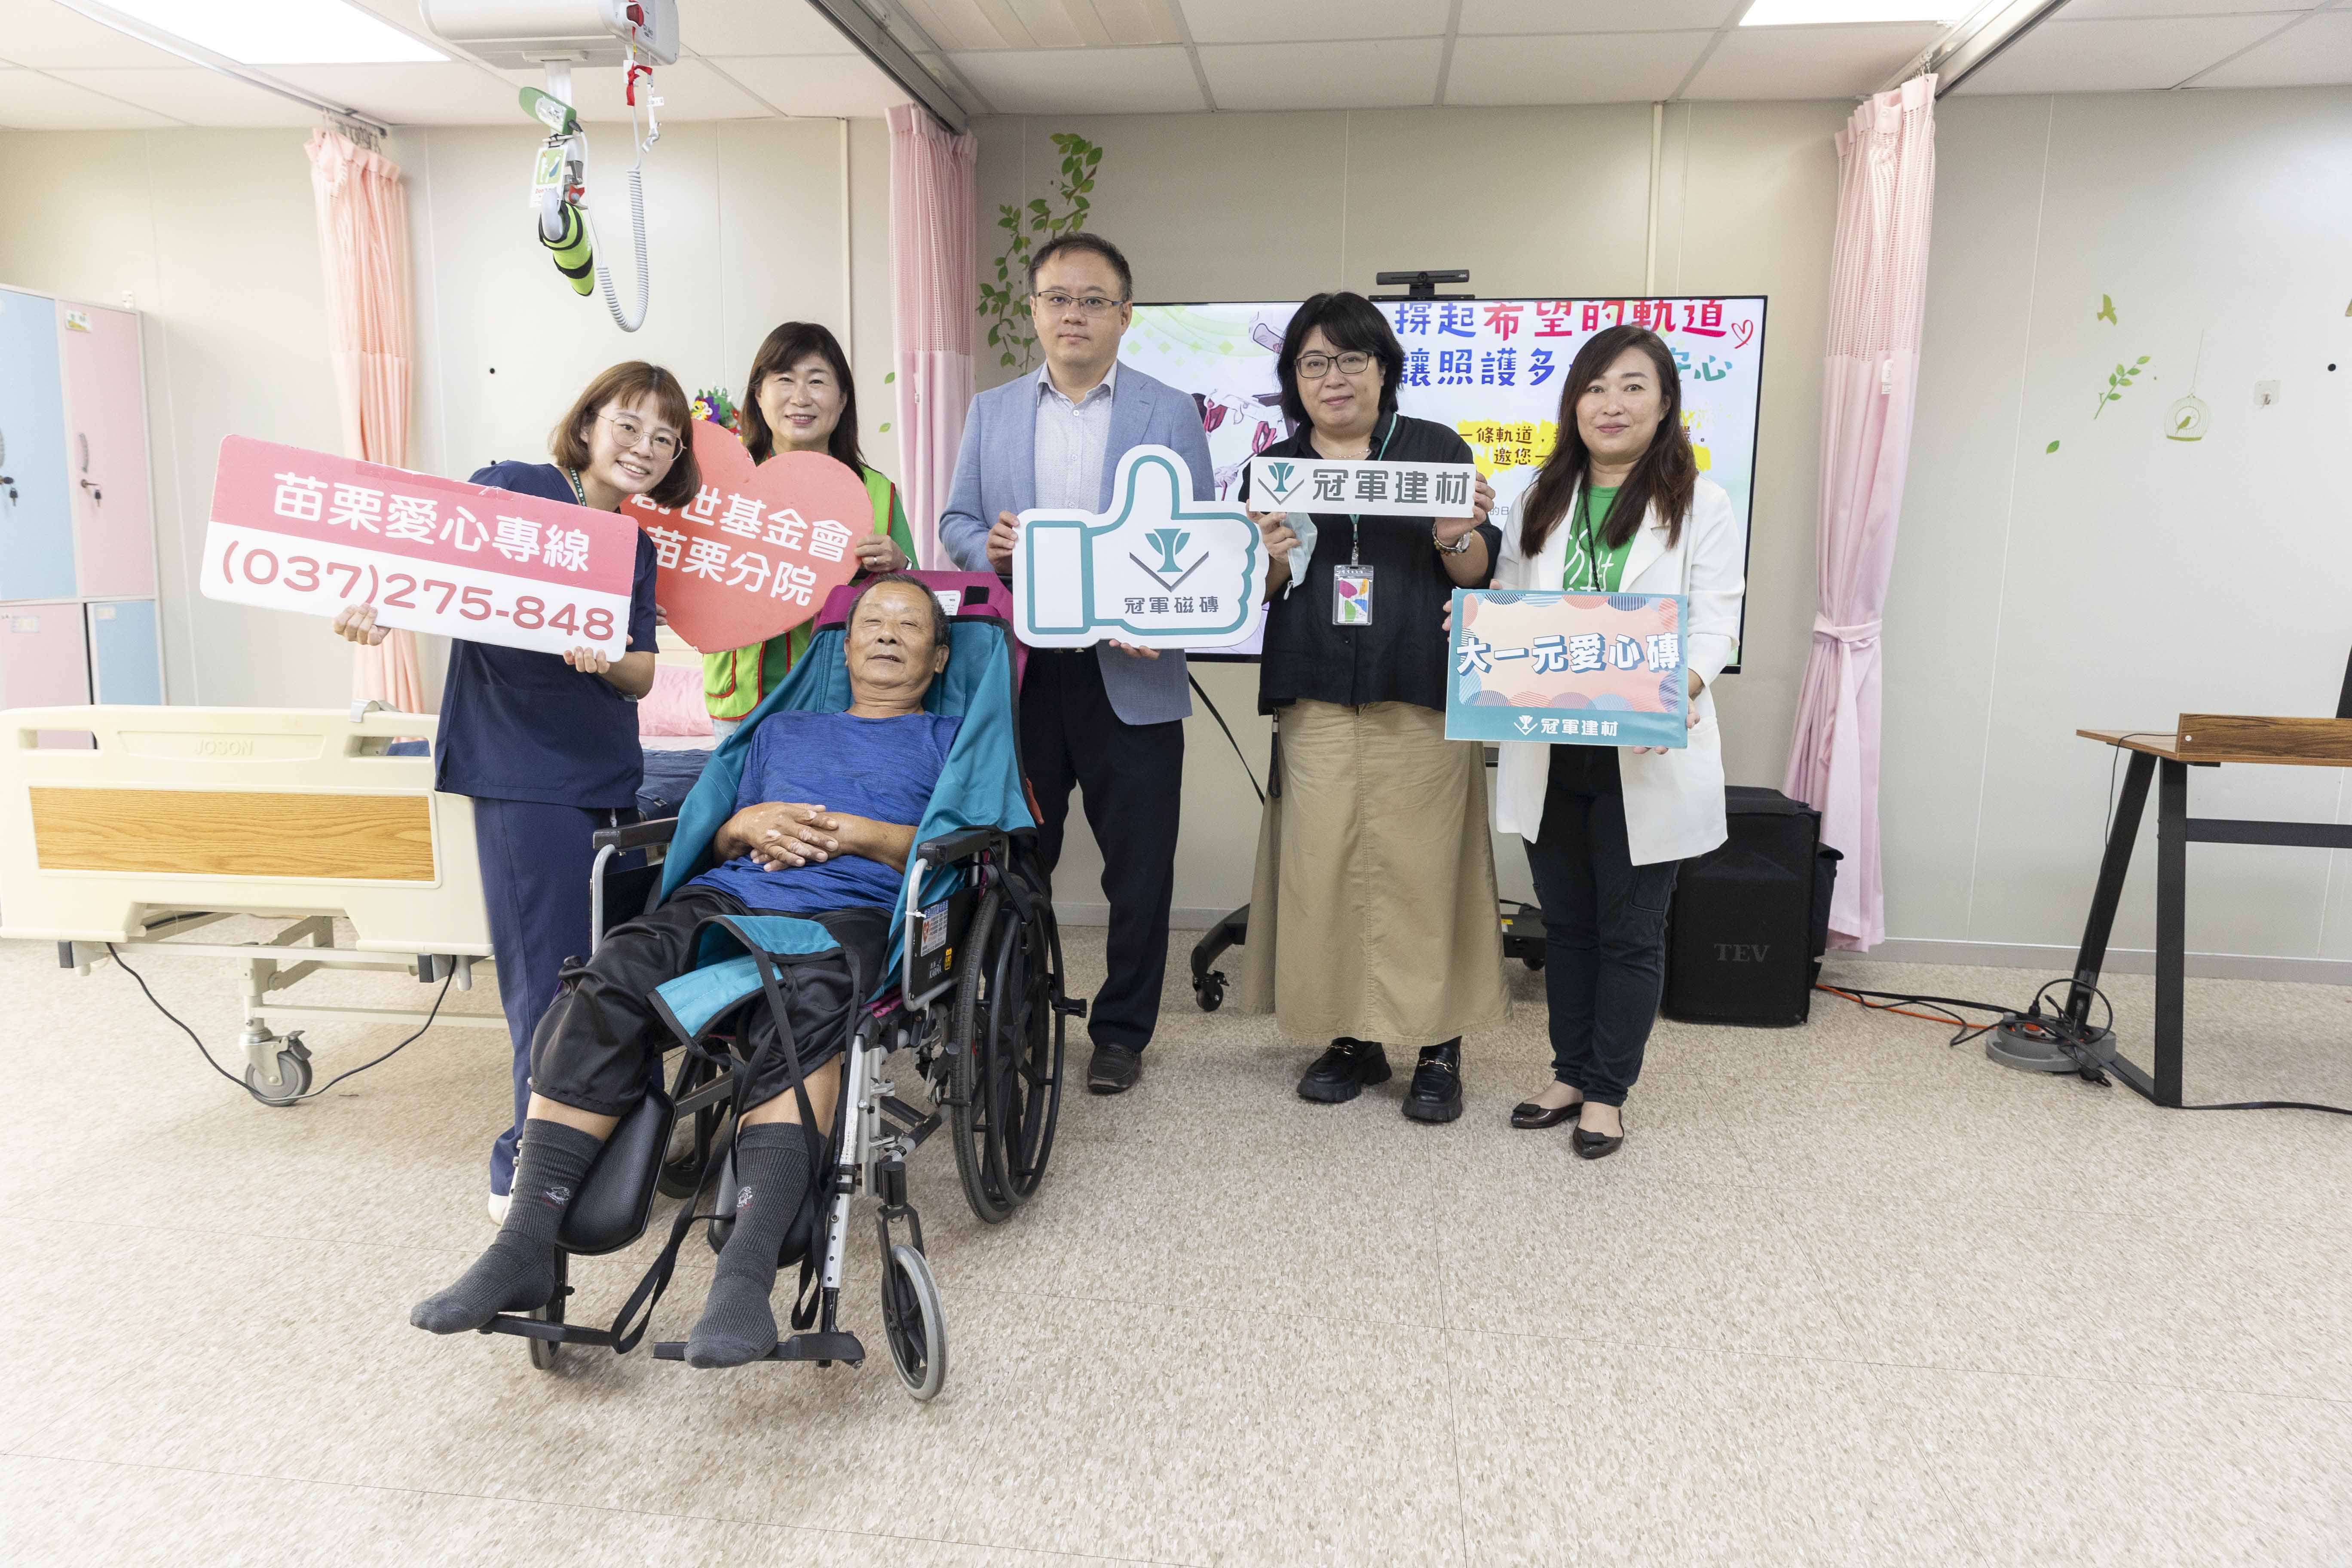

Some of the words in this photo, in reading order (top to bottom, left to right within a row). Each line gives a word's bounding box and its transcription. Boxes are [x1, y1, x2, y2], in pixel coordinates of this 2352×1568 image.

[1395, 299, 1727, 341] 撐起希望的軌道
[1312, 469, 1470, 505] 冠軍建材
[274, 472, 590, 571] 苗栗愛心專線
[646, 526, 817, 606] 苗栗分院
[223, 540, 614, 640] (037)275-848
[1124, 596, 1219, 614] 冠軍磁磚
[1456, 632, 1680, 675] 大一元愛心磚
[1540, 718, 1619, 736] 冠軍建材
[194, 739, 254, 756] JOSON
[1714, 943, 1771, 963] TEV
